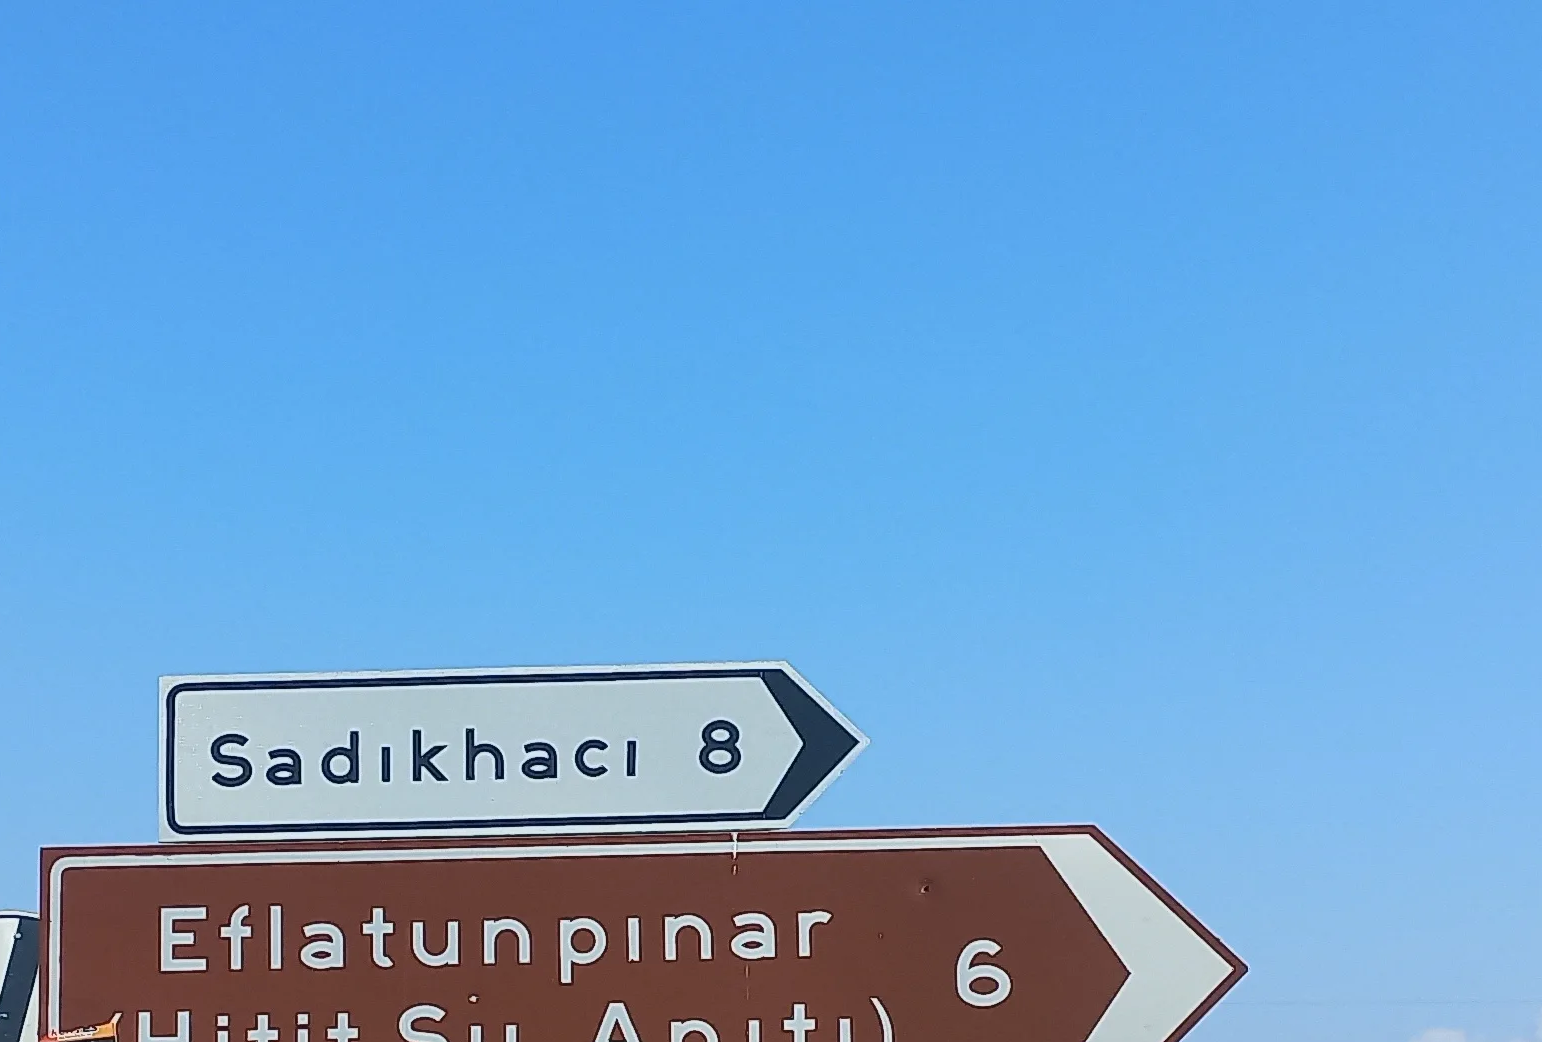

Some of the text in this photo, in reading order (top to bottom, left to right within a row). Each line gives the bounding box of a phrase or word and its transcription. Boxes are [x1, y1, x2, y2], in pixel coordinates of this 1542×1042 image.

[209, 719, 743, 789] Sadıkhacı 8
[159, 903, 834, 985] Eflatunpınar
[955, 938, 1013, 1008] 6
